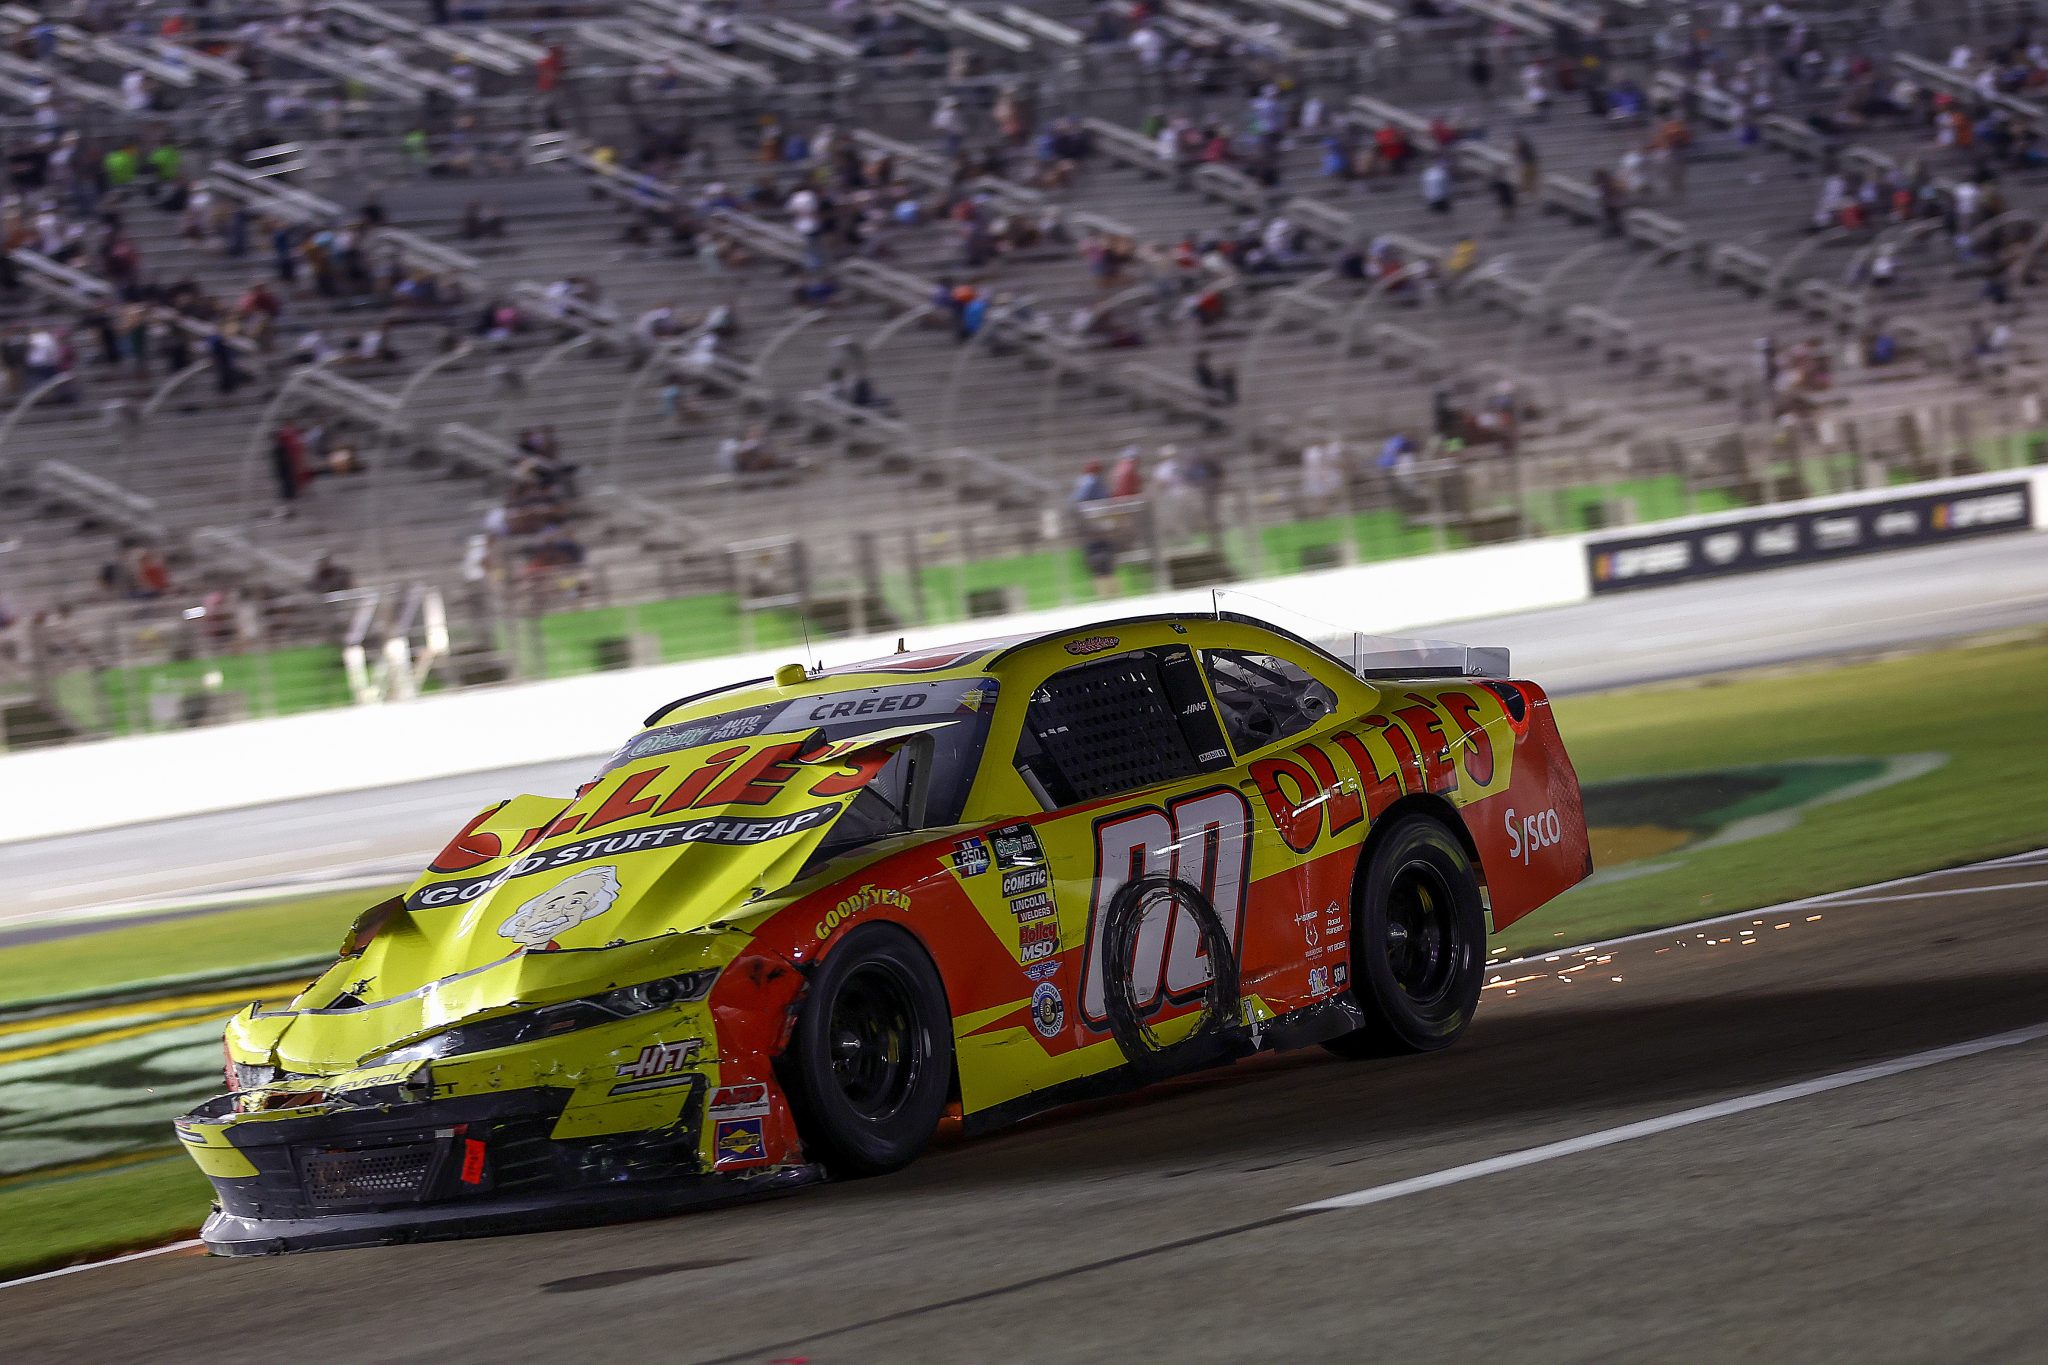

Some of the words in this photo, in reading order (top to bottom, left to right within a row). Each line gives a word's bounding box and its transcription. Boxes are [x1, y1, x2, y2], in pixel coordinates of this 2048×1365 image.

[809, 693, 928, 721] CREED
[720, 715, 762, 731] AUTO
[708, 724, 757, 742] PARTS
[549, 828, 682, 866] STUFF
[961, 848, 981, 866] 250
[1003, 869, 1046, 893] COMETIC
[1011, 893, 1046, 912] LINCOLN
[815, 884, 912, 940] GOODYEAR
[1020, 906, 1051, 922] WELDERS
[1326, 924, 1344, 936] Ranger
[1327, 916, 1341, 927] Road
[1021, 940, 1053, 962] MSD
[1334, 965, 1346, 983] SEM
